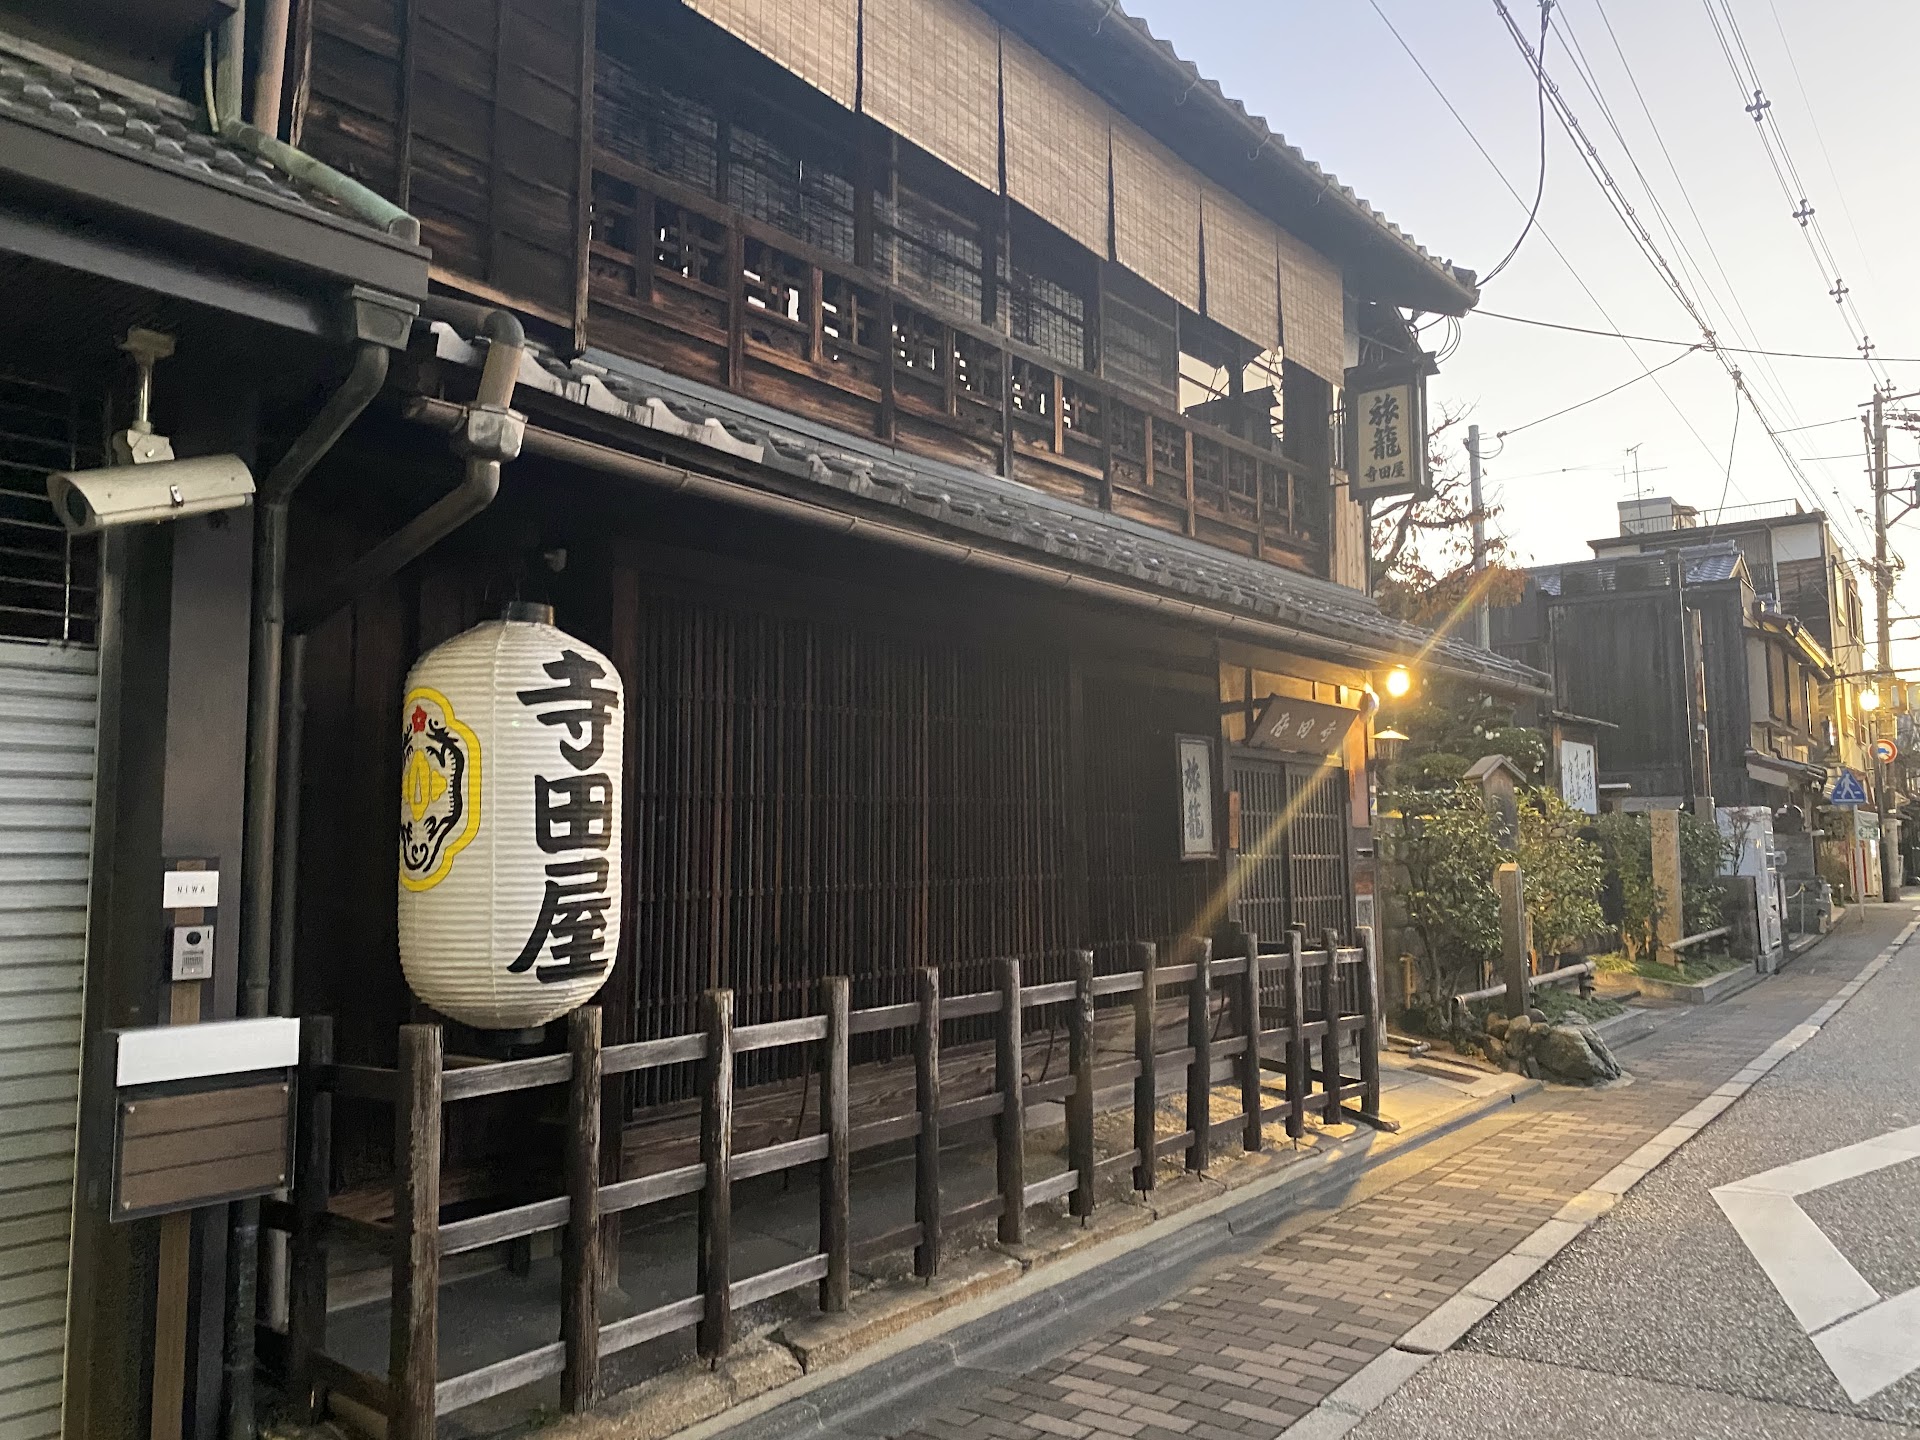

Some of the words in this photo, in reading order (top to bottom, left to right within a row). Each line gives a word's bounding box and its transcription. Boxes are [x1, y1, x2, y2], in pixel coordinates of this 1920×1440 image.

[1368, 393, 1402, 460] 旅籠
[1364, 461, 1405, 482] 寺田屋
[508, 649, 619, 984] 寺田屋
[177, 885, 205, 894] NIWA
